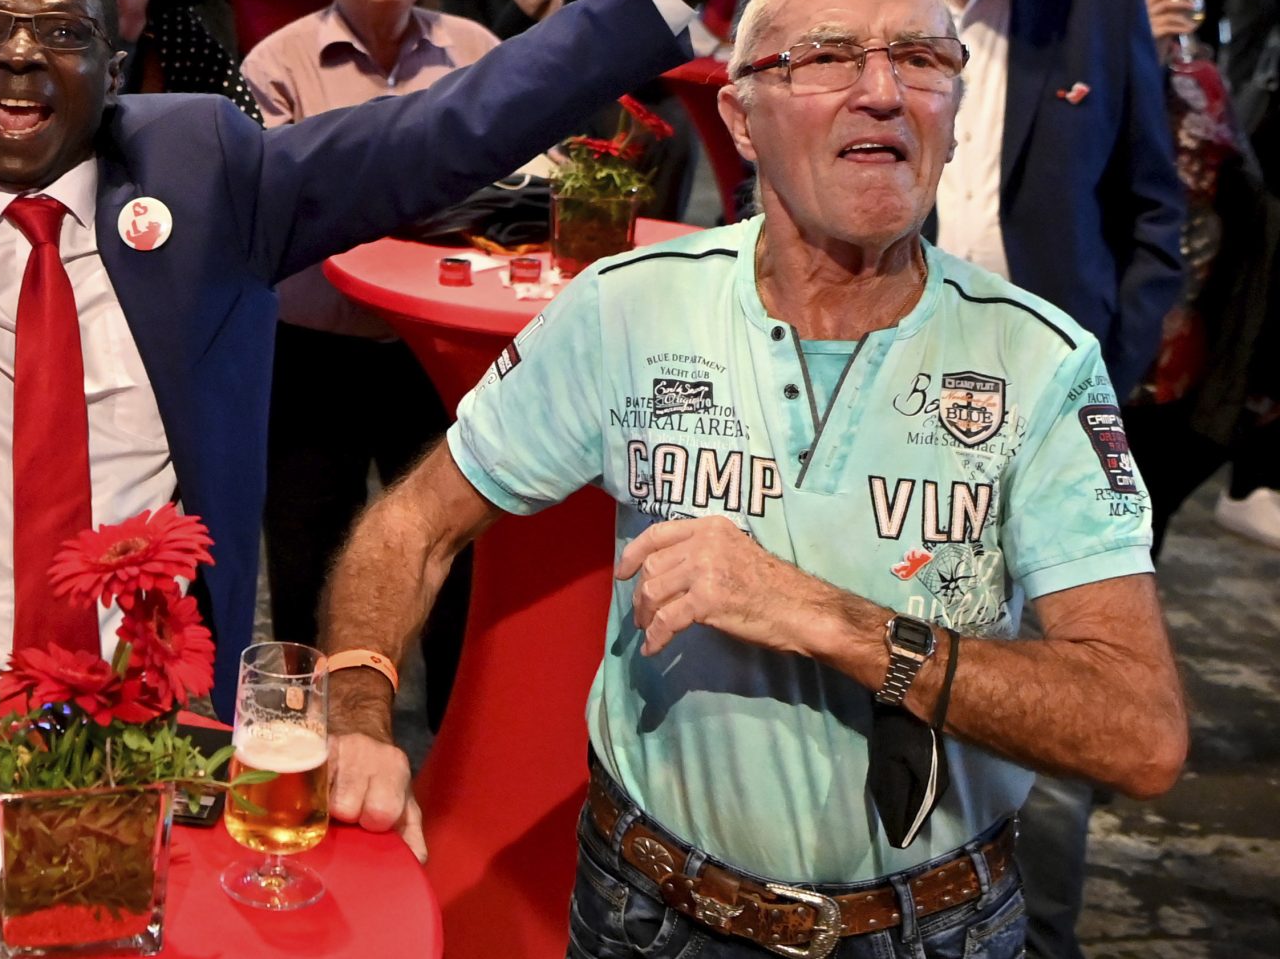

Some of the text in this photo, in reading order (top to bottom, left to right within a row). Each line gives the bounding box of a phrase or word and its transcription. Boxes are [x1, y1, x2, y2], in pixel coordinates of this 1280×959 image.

[646, 353, 670, 366] BLUE
[660, 366, 689, 379] YACHT
[1067, 377, 1095, 402] BLUE
[609, 408, 689, 433] NATURAL
[945, 407, 994, 424] BLUE
[628, 440, 783, 517] CAMP
